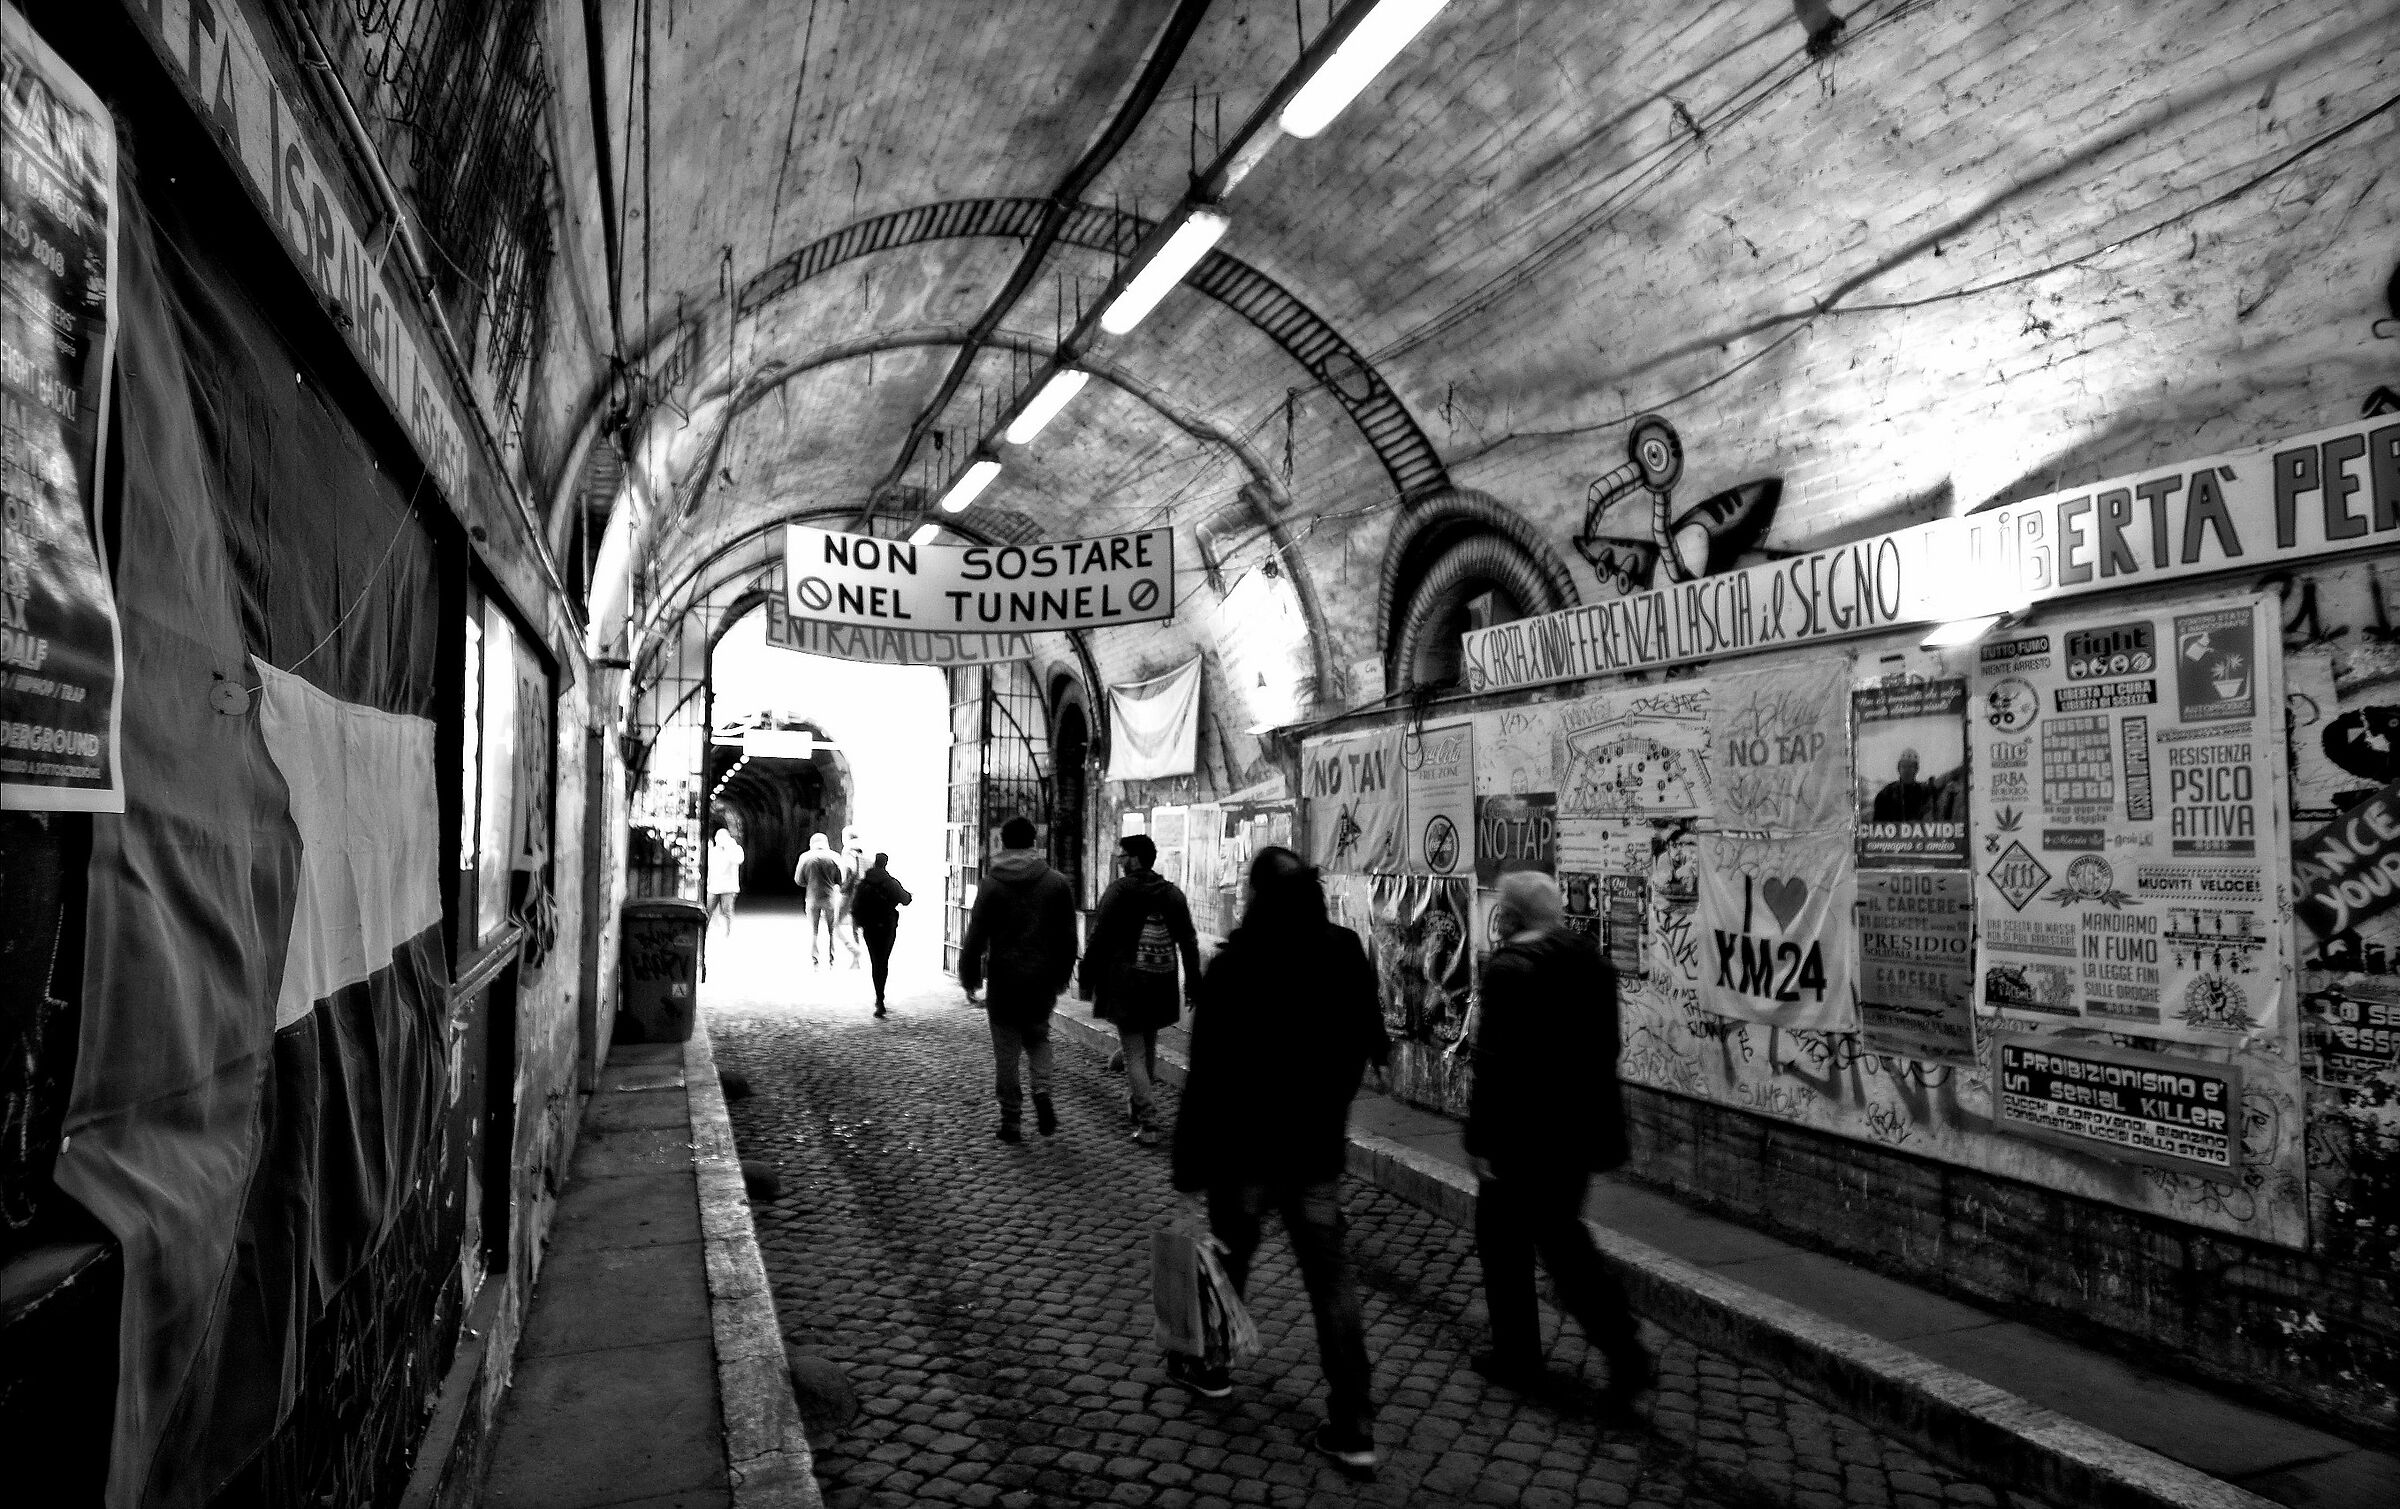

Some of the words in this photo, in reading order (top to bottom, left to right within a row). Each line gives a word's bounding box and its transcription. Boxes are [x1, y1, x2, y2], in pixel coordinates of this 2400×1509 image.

[824, 534, 917, 576] NON
[960, 533, 1153, 580] SOSTARE
[1792, 537, 1901, 638] SEGNO
[838, 582, 912, 620] NEL
[945, 584, 1122, 623] TUNNEL
[2019, 636, 2049, 655] FUMO
[2070, 628, 2148, 656] Fight
[1729, 739, 1769, 767] NO
[1775, 731, 1826, 764] TAP
[2169, 743, 2251, 767] RESISTENZA
[1315, 756, 1341, 797] NO
[1347, 748, 1388, 794] TAV
[2171, 765, 2253, 803] PSICO
[1857, 822, 1897, 839] CIAO
[1901, 822, 1964, 839] DAVIDE
[2172, 804, 2254, 837] ATTIVA
[1479, 817, 1508, 860] NO
[1512, 816, 1552, 860] TAP
[1891, 876, 1932, 895] ODIO
[2139, 879, 2192, 890] MUOVITI
[2201, 880, 2260, 892] VELOCE!
[1743, 874, 1753, 934] I
[2082, 912, 2158, 934] MANDIAMO
[1864, 933, 1967, 954] PRESIDIO
[2082, 934, 2099, 960] IN
[2106, 936, 2158, 963] FUMO
[1715, 928, 1827, 1003] XM24
[2082, 962, 2097, 978] LA
[2100, 963, 2134, 982] LEGGE
[2083, 981, 2114, 998] SULLE
[2002, 1048, 2020, 1068] IL
